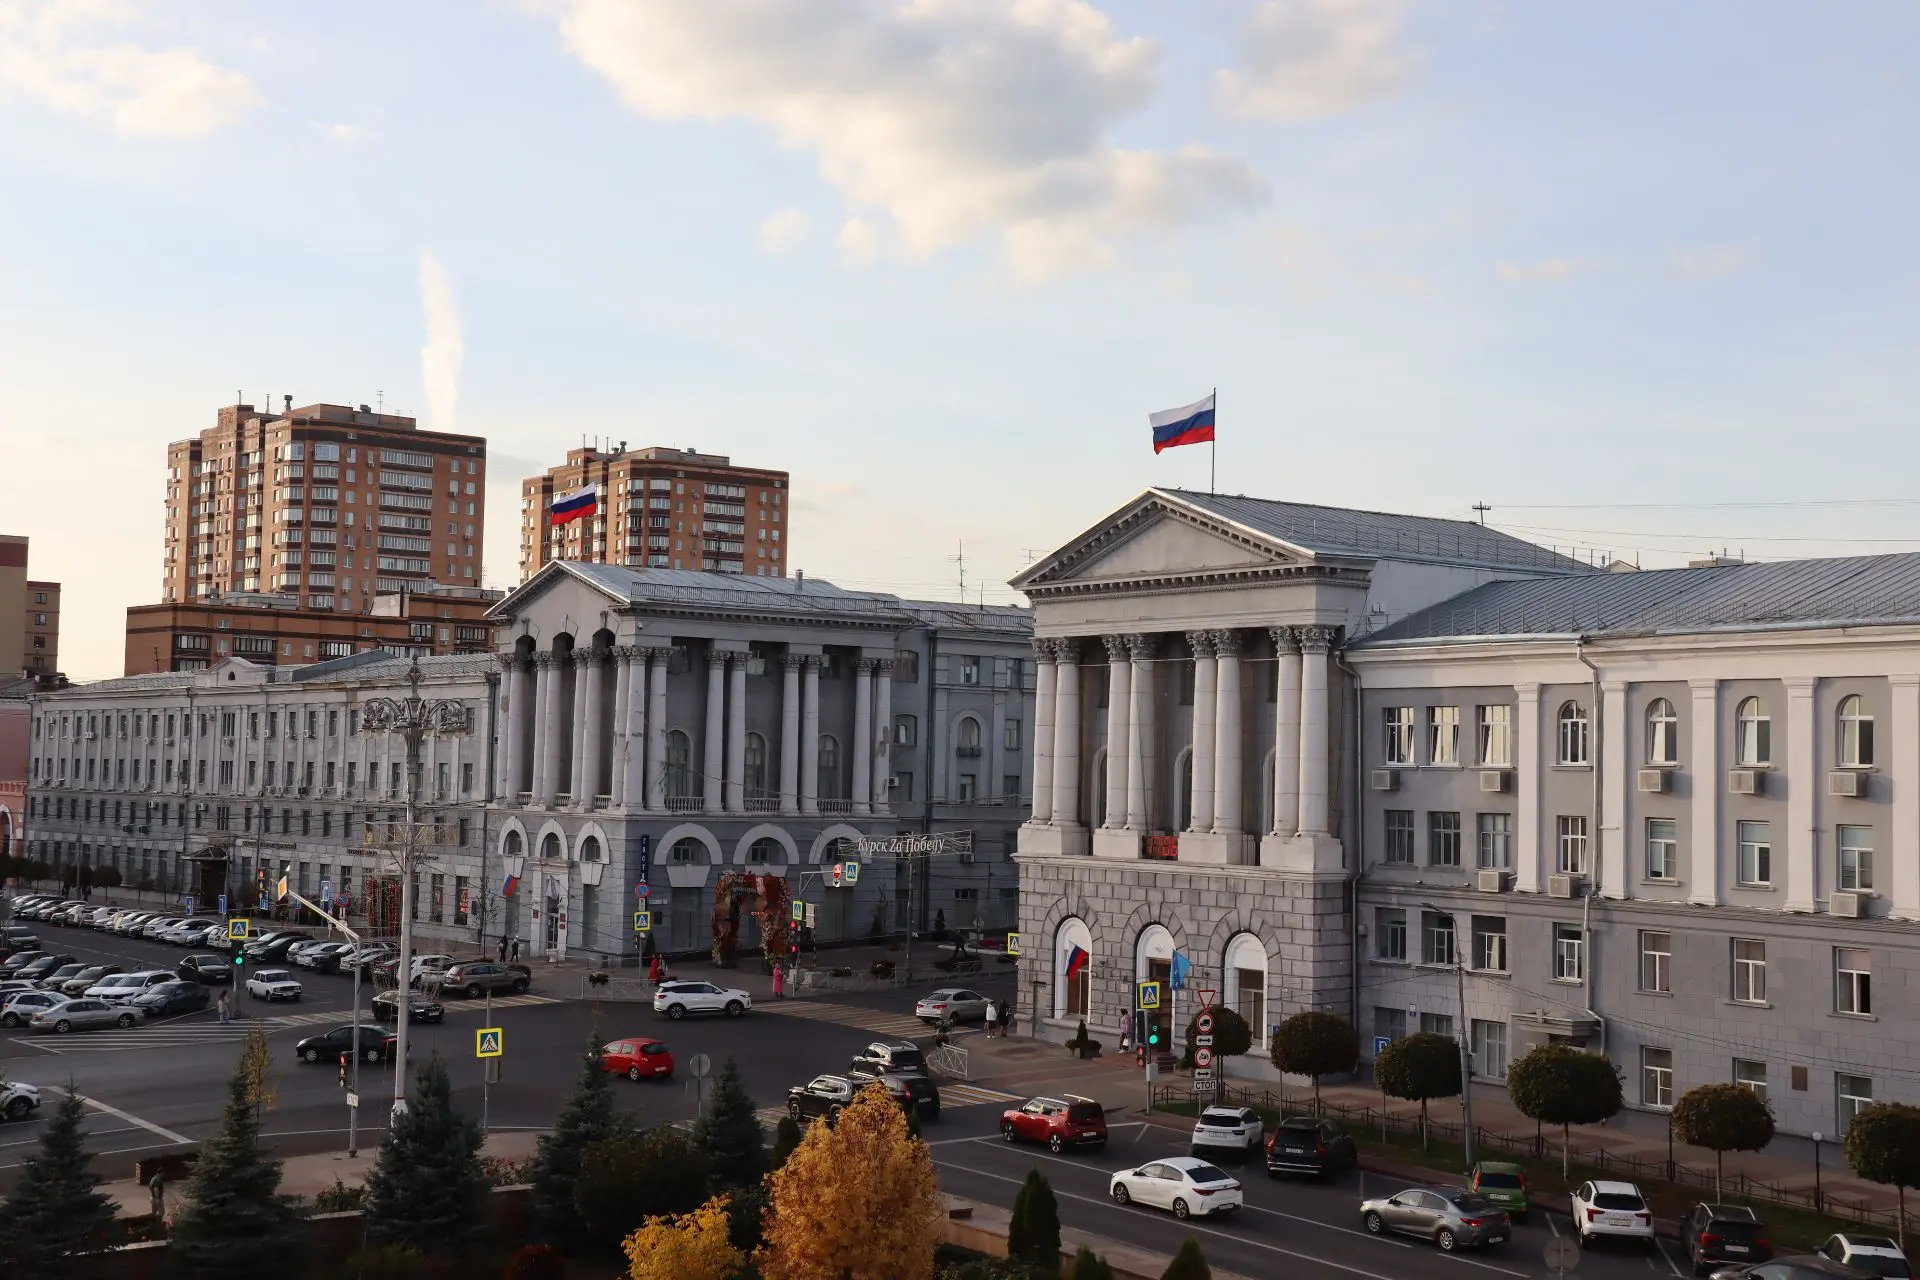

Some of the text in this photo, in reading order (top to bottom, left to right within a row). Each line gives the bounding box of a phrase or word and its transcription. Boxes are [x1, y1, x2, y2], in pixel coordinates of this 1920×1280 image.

[858, 837, 944, 855] Курск Za Победу
[1196, 1081, 1215, 1089] СТОП
